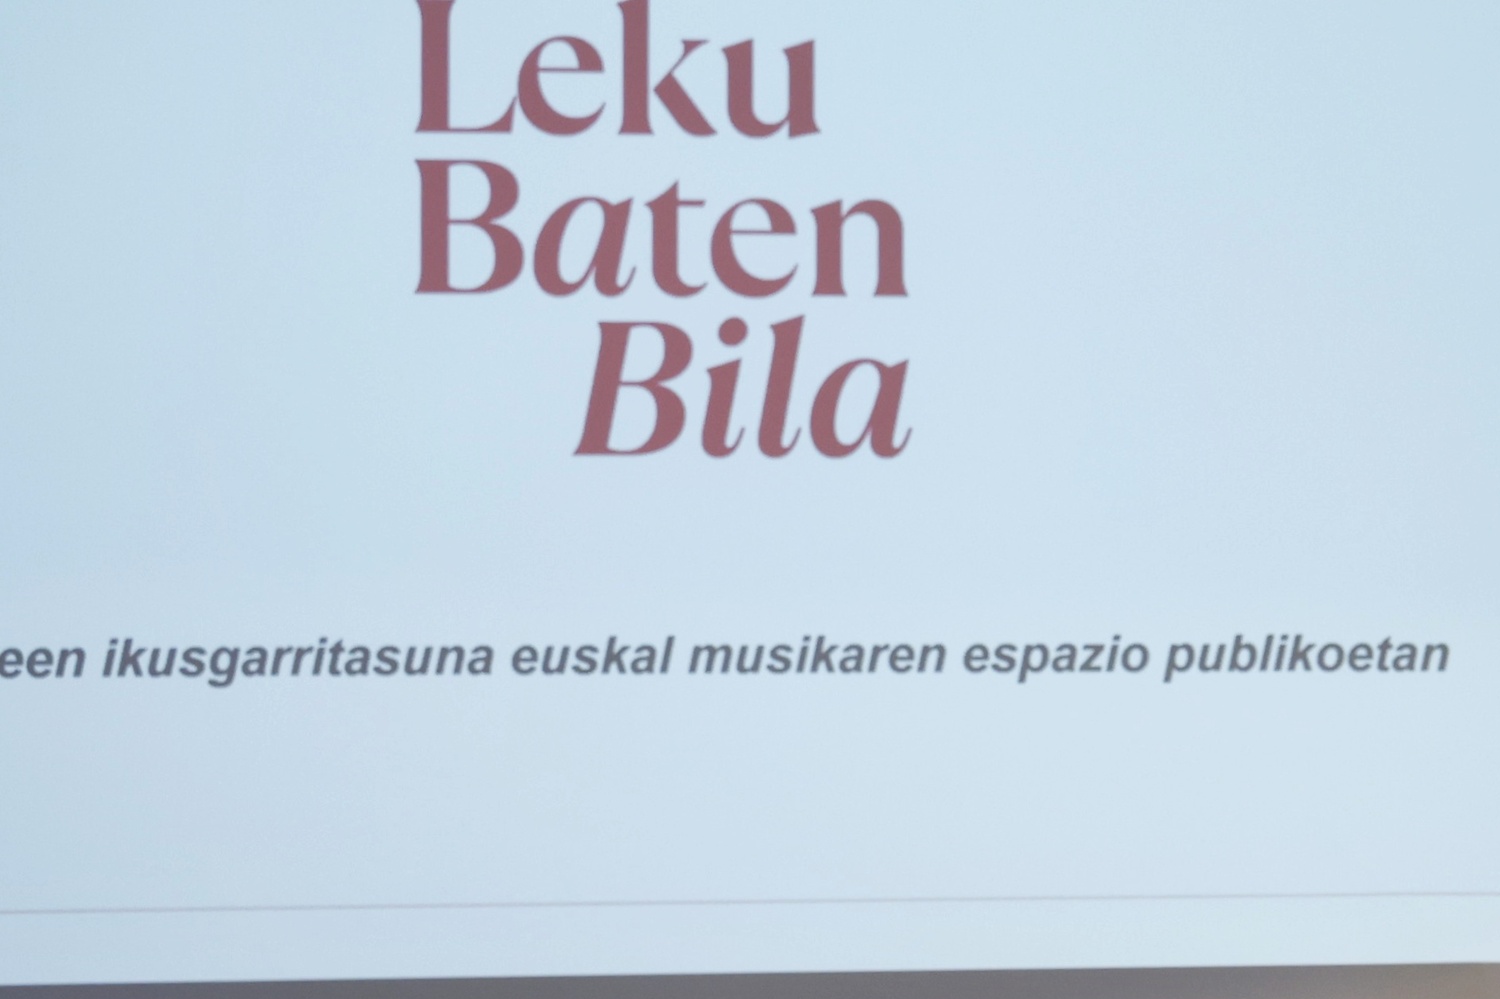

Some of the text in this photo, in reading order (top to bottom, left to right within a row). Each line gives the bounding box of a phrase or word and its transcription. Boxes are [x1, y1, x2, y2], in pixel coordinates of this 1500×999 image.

[415, 0, 820, 138] Leku
[414, 159, 908, 298] Baten
[573, 315, 912, 459] Bila
[102, 637, 494, 688] ikusgarritasuna
[511, 636, 675, 675] euskal
[688, 635, 946, 674] musikaren
[963, 634, 1150, 684] espazio
[1163, 634, 1449, 683] publikoetan
